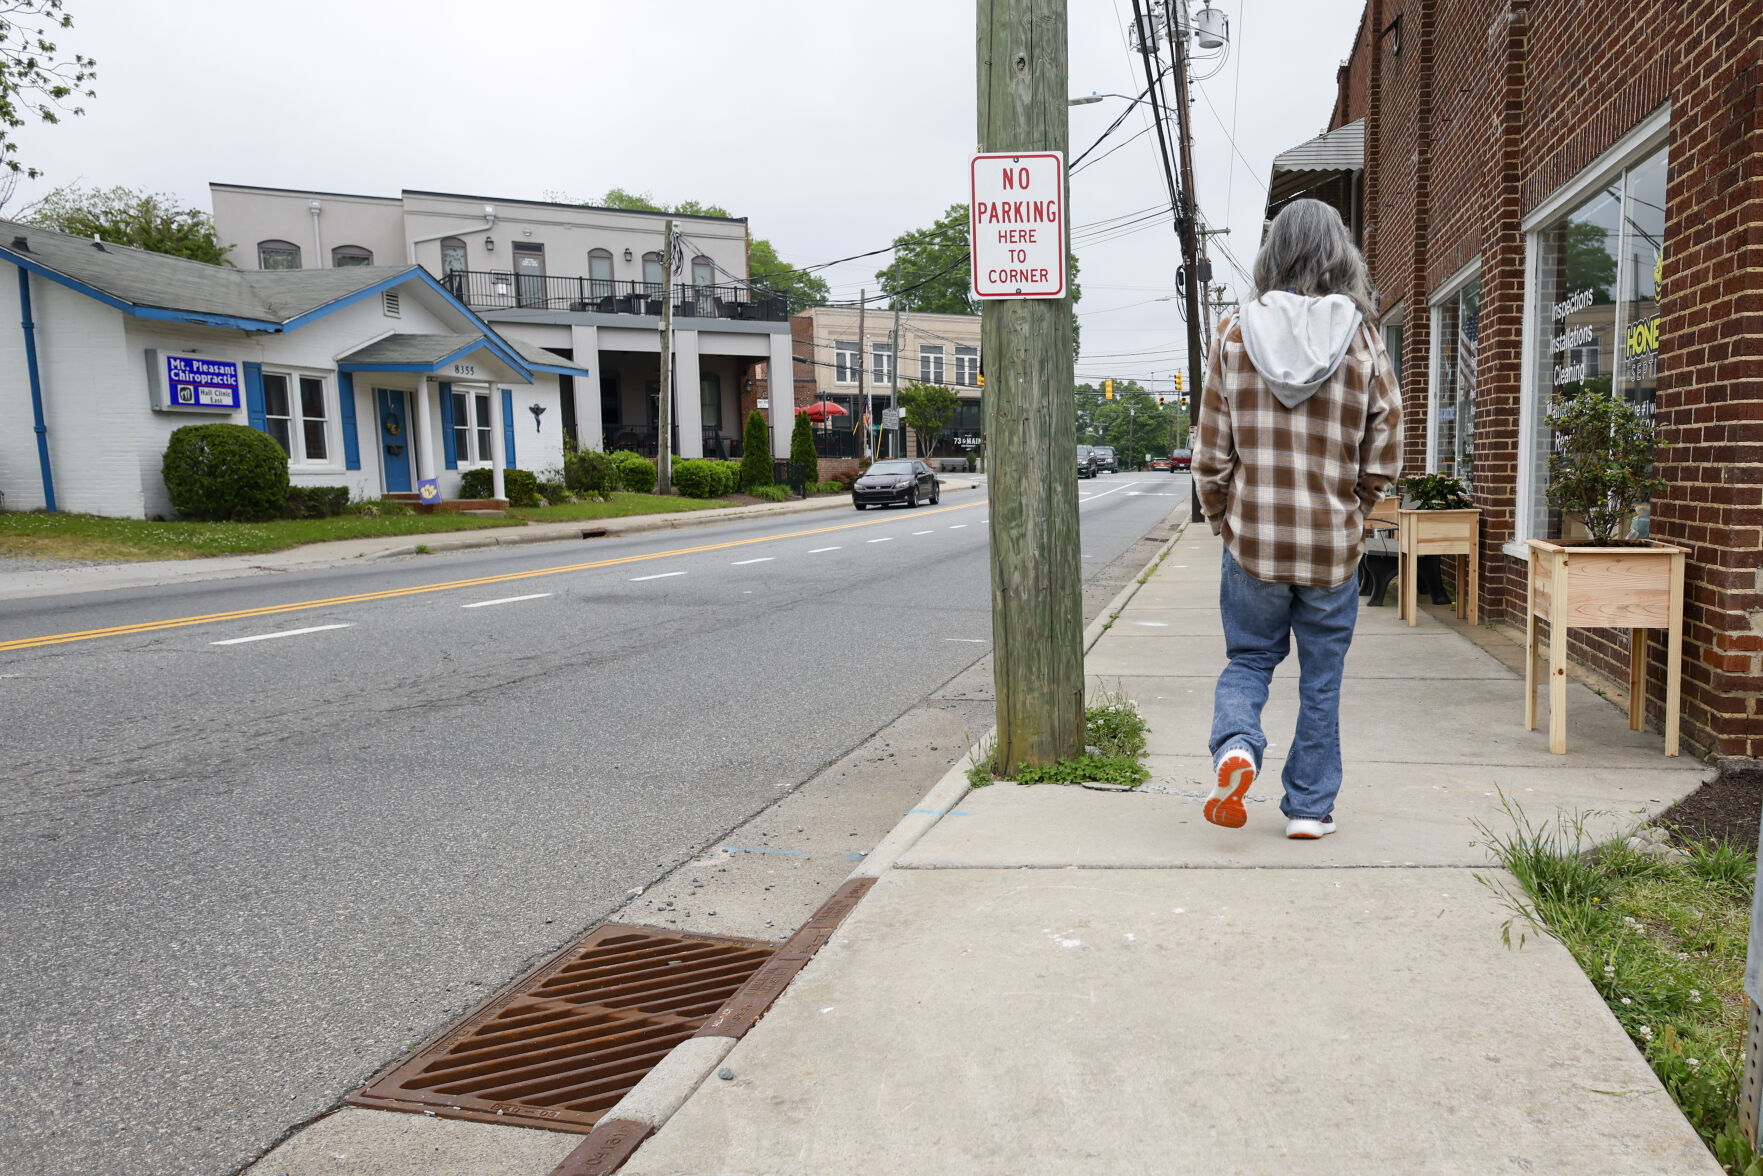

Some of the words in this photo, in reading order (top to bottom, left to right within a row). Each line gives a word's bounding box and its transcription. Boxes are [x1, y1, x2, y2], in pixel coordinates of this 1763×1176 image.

[1002, 167, 1030, 191] NO
[978, 200, 1057, 224] PARKING
[998, 229, 1037, 244] HERE
[1008, 249, 1027, 264] TO
[988, 268, 1049, 284] CORNER
[1551, 287, 1594, 324] Inspections
[1549, 324, 1593, 355] Installations
[1626, 316, 1662, 360] HONE
[170, 358, 190, 370] Mt.
[192, 360, 235, 374] Pleasant
[454, 364, 475, 376] 8355
[1553, 361, 1585, 386] Cleaning
[170, 370, 237, 384] Chiropractic
[200, 388, 213, 397] Hall
[214, 389, 231, 398] Clinic
[953, 437, 962, 445] 73
